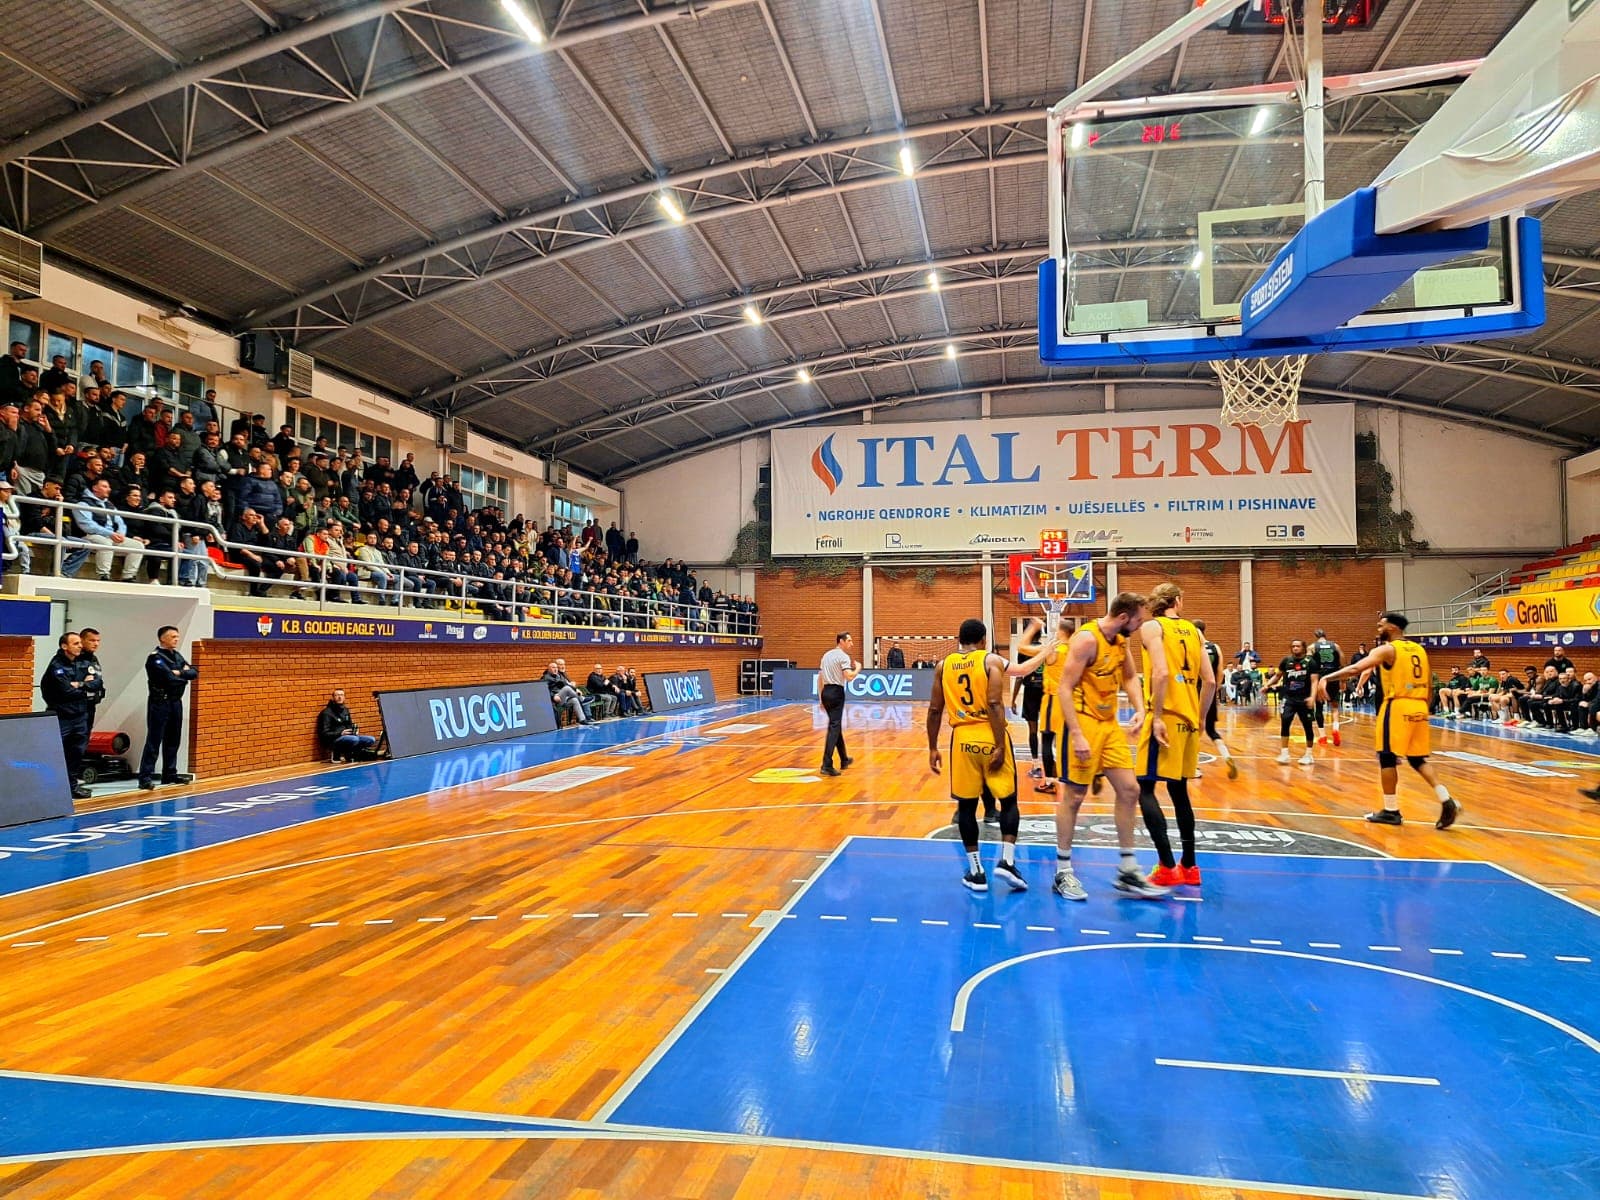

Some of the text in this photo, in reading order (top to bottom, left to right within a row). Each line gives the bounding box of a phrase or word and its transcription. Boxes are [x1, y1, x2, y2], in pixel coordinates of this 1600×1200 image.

[857, 419, 1312, 487] ITAL TERM
[818, 507, 950, 521] NGROHJE QENDRORE
[970, 504, 1047, 517] KLIMATIZIM
[1069, 500, 1146, 514] UJËSJELLËS
[1168, 500, 1224, 512] FILTRIM
[1238, 498, 1316, 510] PISHINAVE
[1266, 525, 1288, 537] G3
[816, 537, 843, 550] Ferroli
[1043, 541, 1060, 554] 23
[1517, 598, 1557, 625] Graniti
[281, 620, 395, 636] K.B. GOLDEN EAGLE YLLI
[1180, 639, 1191, 671] 1
[1411, 654, 1423, 679] 8
[663, 676, 703, 705] RUGOVE
[958, 674, 974, 706] 3
[429, 691, 527, 740] RUGOVE
[176, 784, 349, 815] EAGLE
